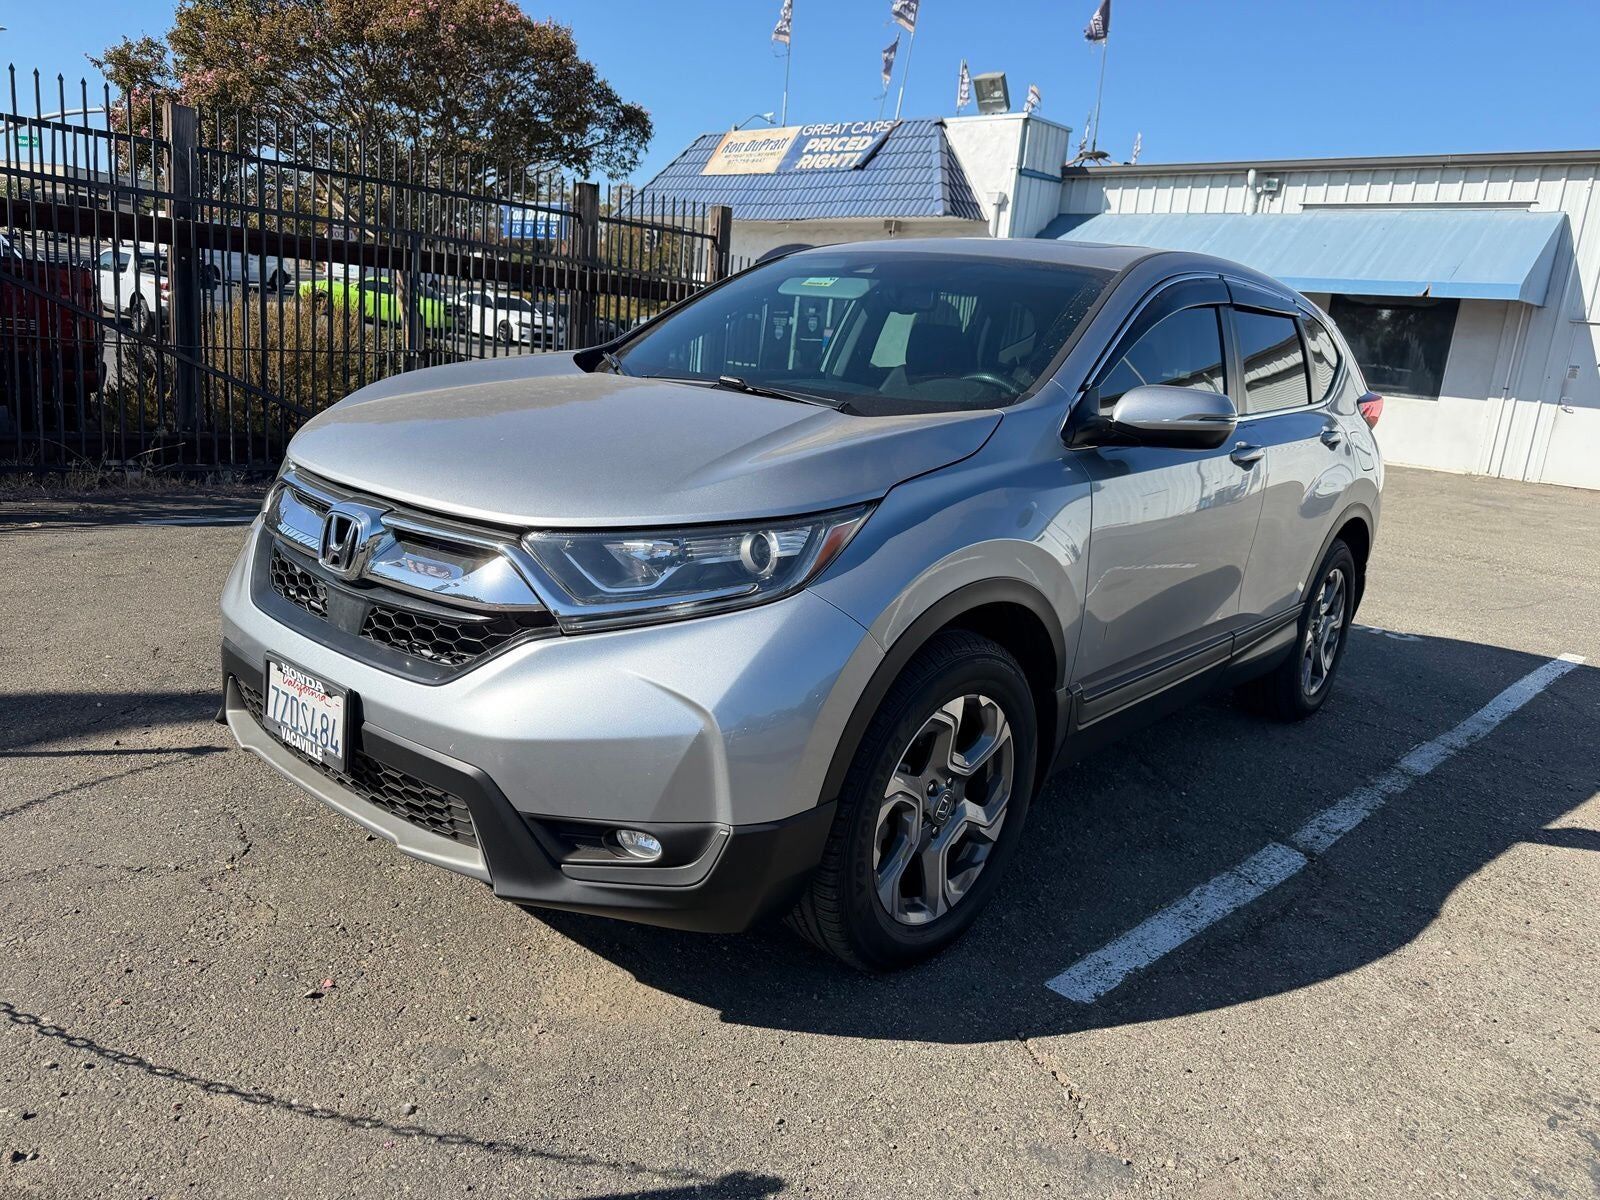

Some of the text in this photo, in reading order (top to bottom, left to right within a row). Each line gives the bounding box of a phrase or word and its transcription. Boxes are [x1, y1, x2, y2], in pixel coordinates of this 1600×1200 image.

[802, 120, 895, 136] GREAT CARS
[721, 137, 790, 154] Ron DuPratt
[802, 136, 873, 153] PRICED
[281, 662, 325, 694] HONDA
[272, 684, 339, 755] 7ZDS484
[281, 725, 323, 762] VACAVILLE
